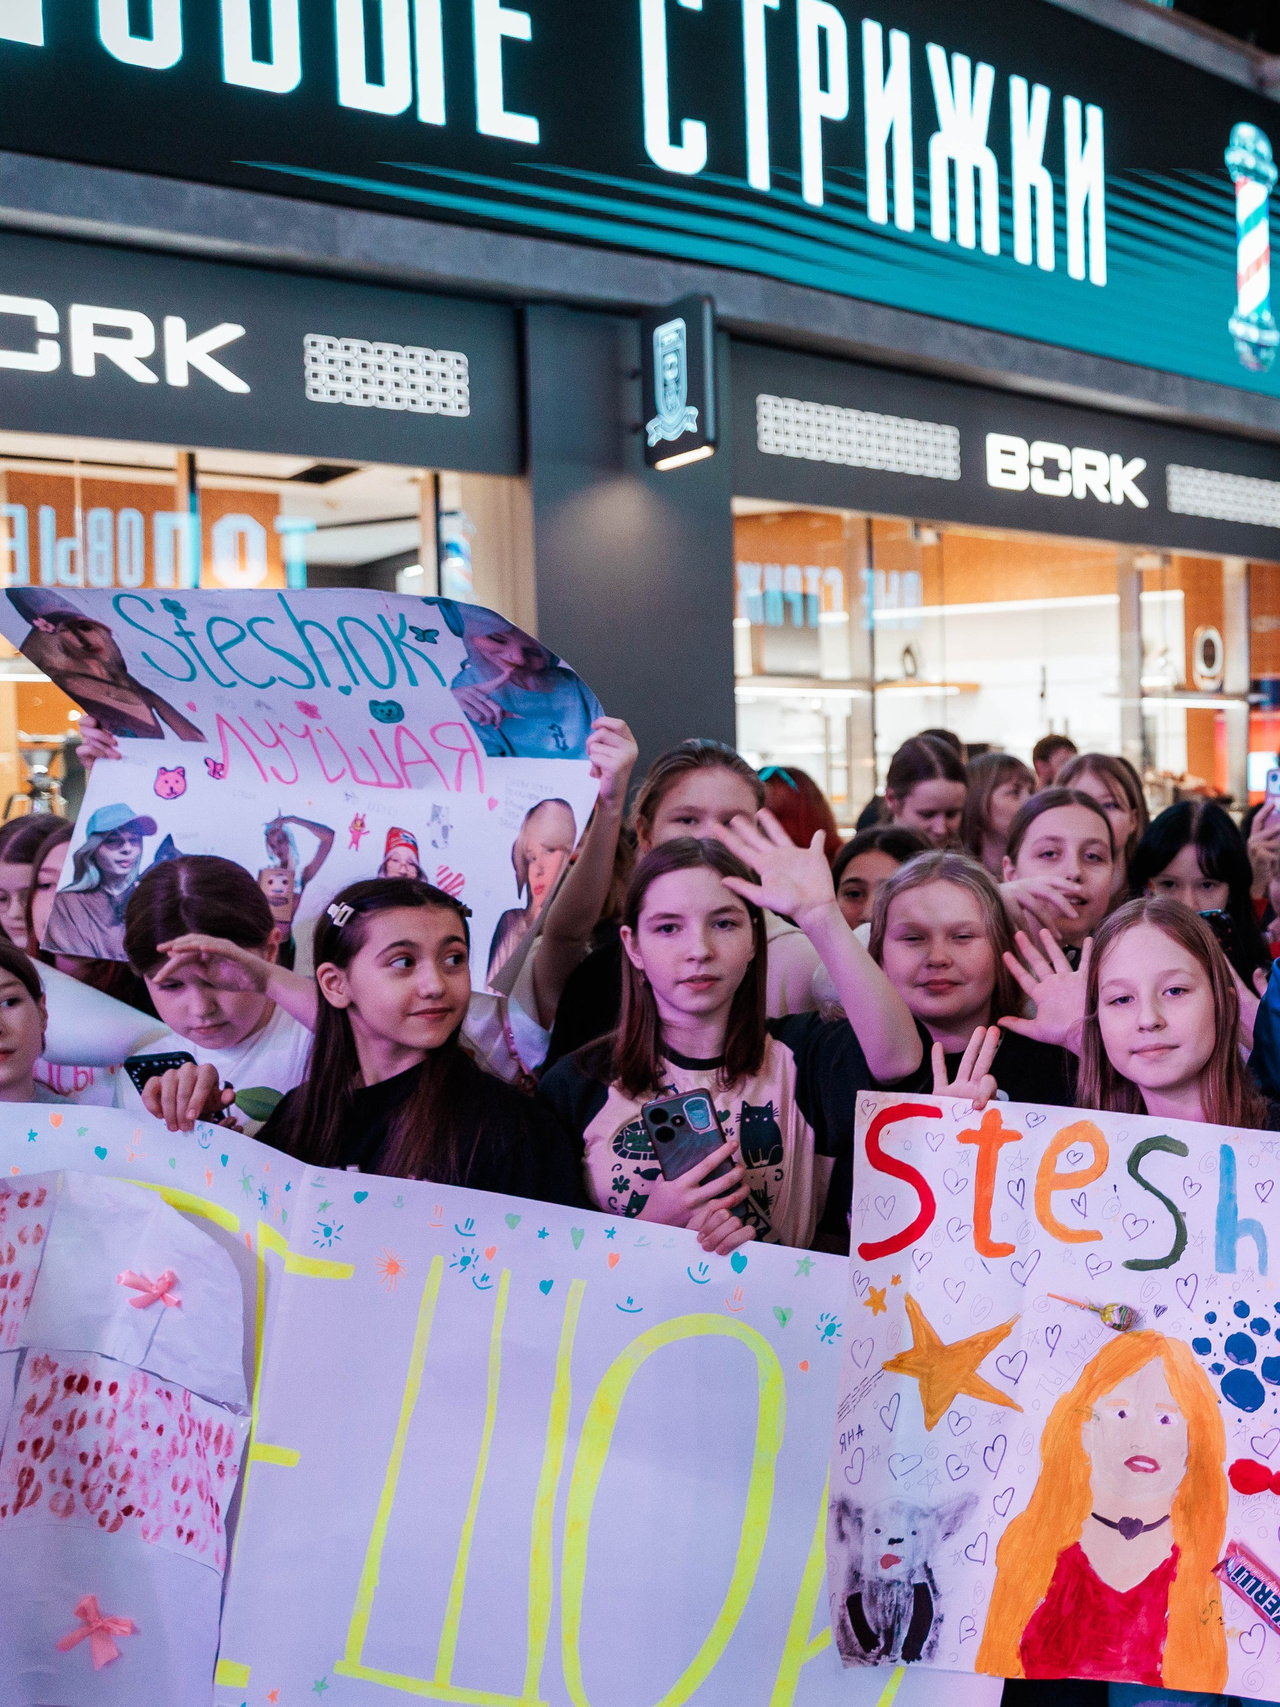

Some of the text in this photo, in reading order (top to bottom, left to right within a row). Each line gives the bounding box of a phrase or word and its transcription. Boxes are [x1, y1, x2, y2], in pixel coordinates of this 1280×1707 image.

[639, 0, 1107, 288] СТРИЖКИ
[985, 432, 1149, 508] BORK
[839, 1423, 865, 1455] ЯНА
